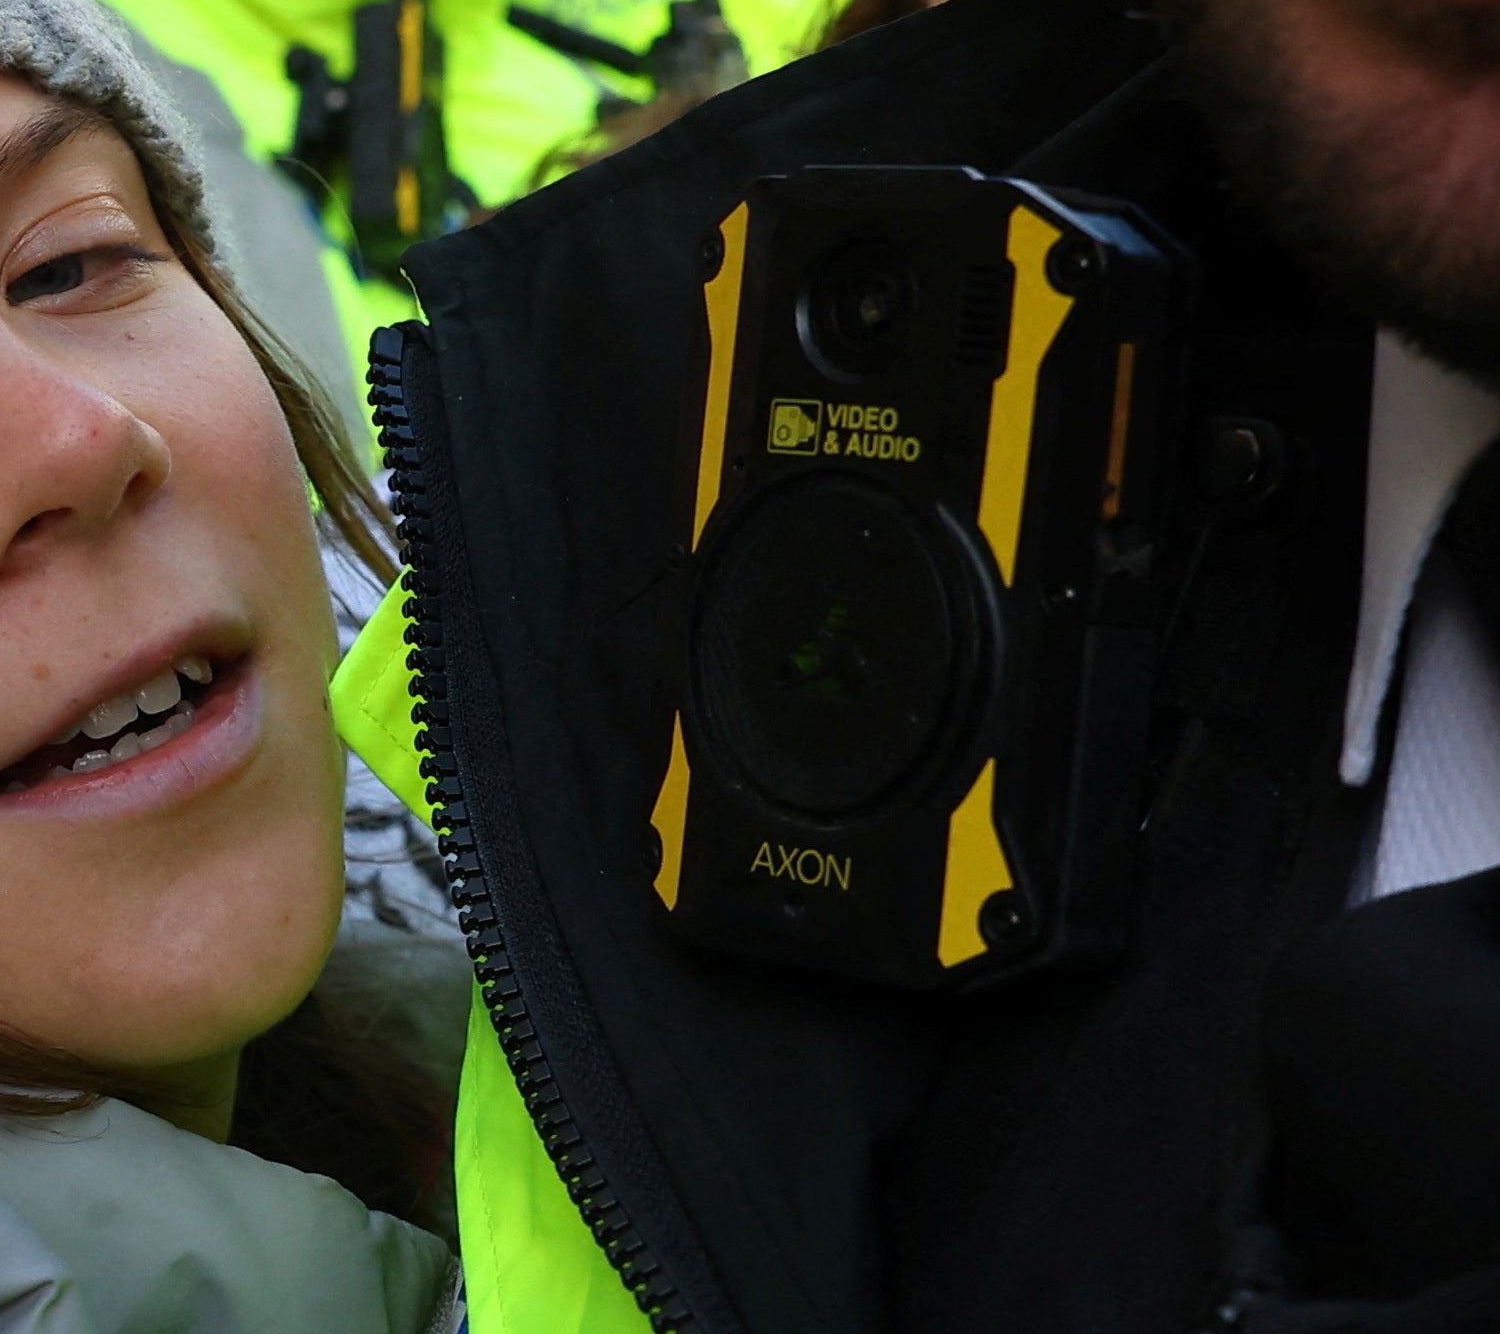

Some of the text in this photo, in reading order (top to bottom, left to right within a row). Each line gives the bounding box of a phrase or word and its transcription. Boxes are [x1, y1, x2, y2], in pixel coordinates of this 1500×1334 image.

[827, 403, 898, 432] VIDEO
[823, 430, 921, 462] & AUDIO
[750, 841, 852, 890] AXON
